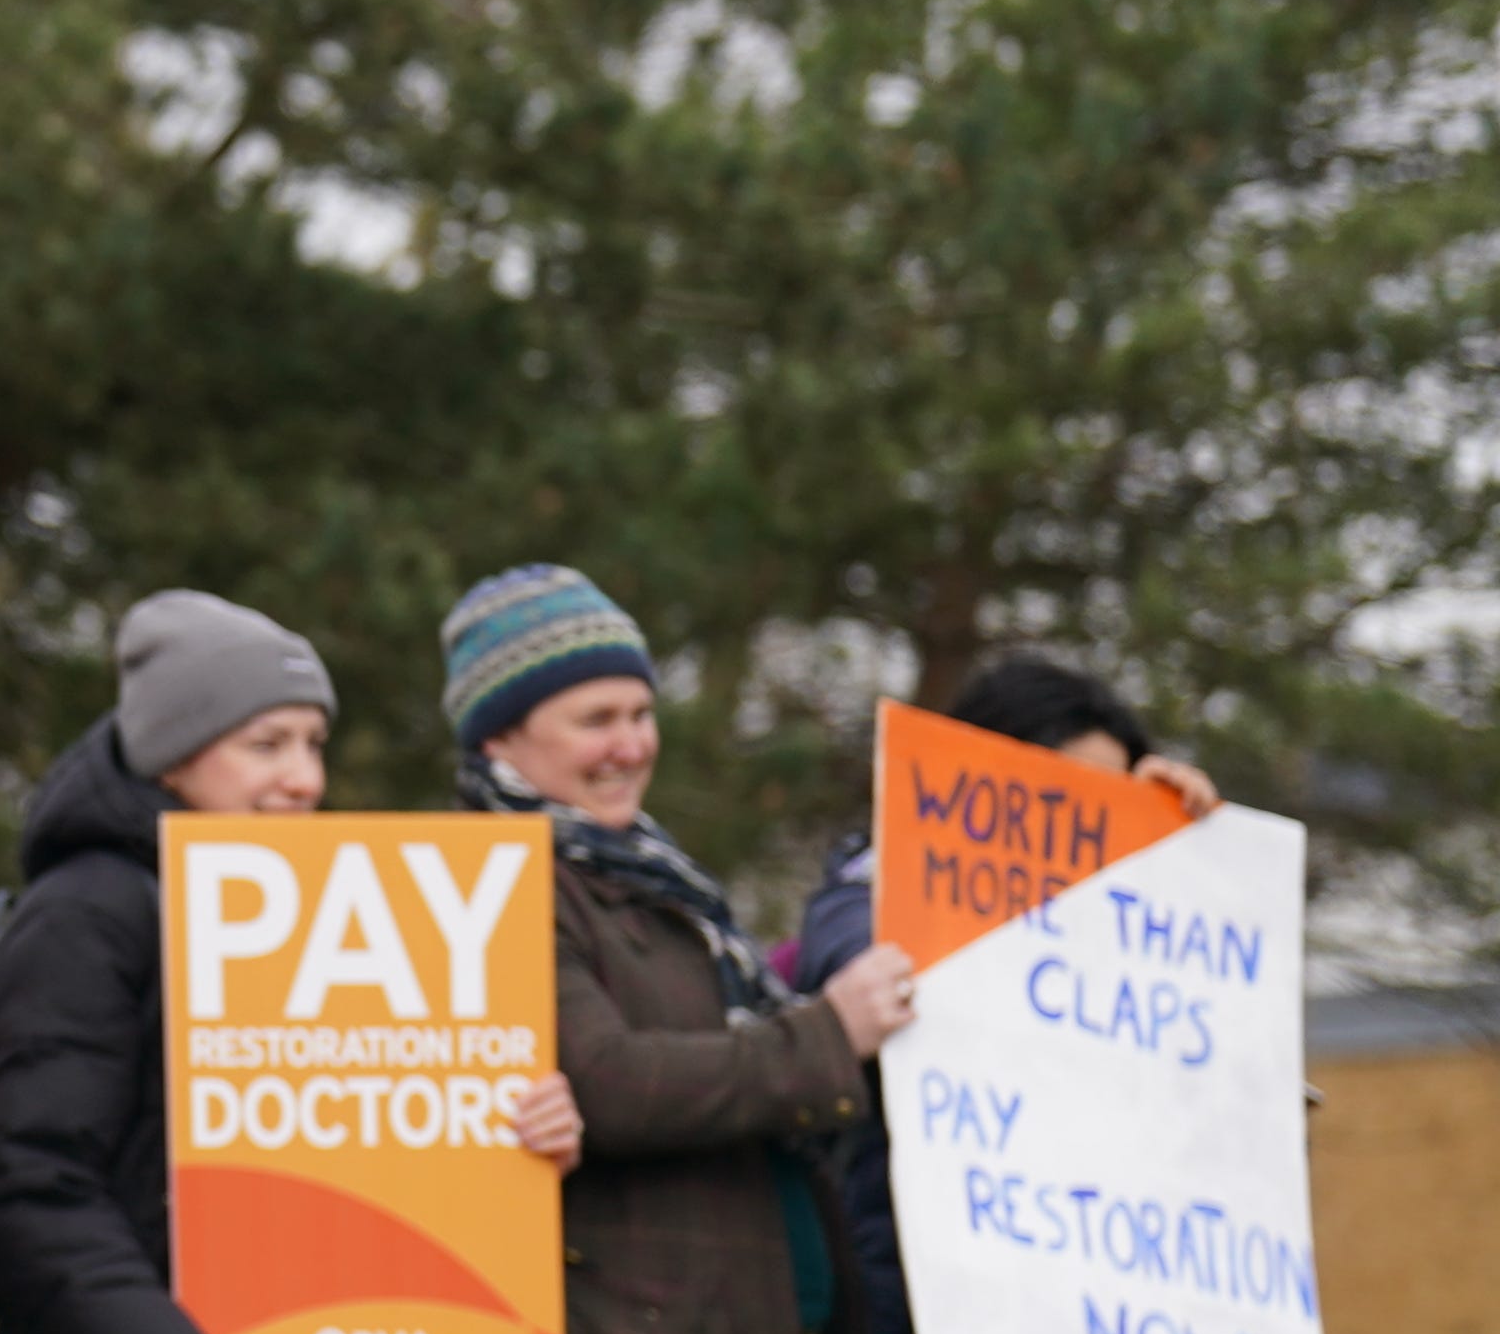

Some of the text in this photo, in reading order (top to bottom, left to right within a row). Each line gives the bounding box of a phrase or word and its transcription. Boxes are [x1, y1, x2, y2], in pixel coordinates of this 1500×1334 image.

[912, 759, 1108, 868] WORTH
[183, 842, 530, 1020] PAY
[924, 846, 1263, 985] MORE THAN
[189, 1028, 536, 1067] RESTORATION FOR
[1028, 958, 1214, 1067] CLAPS
[191, 1075, 530, 1150] DOCTORS
[921, 1069, 1022, 1155] PAY
[966, 1167, 1318, 1320] RESTORATION
